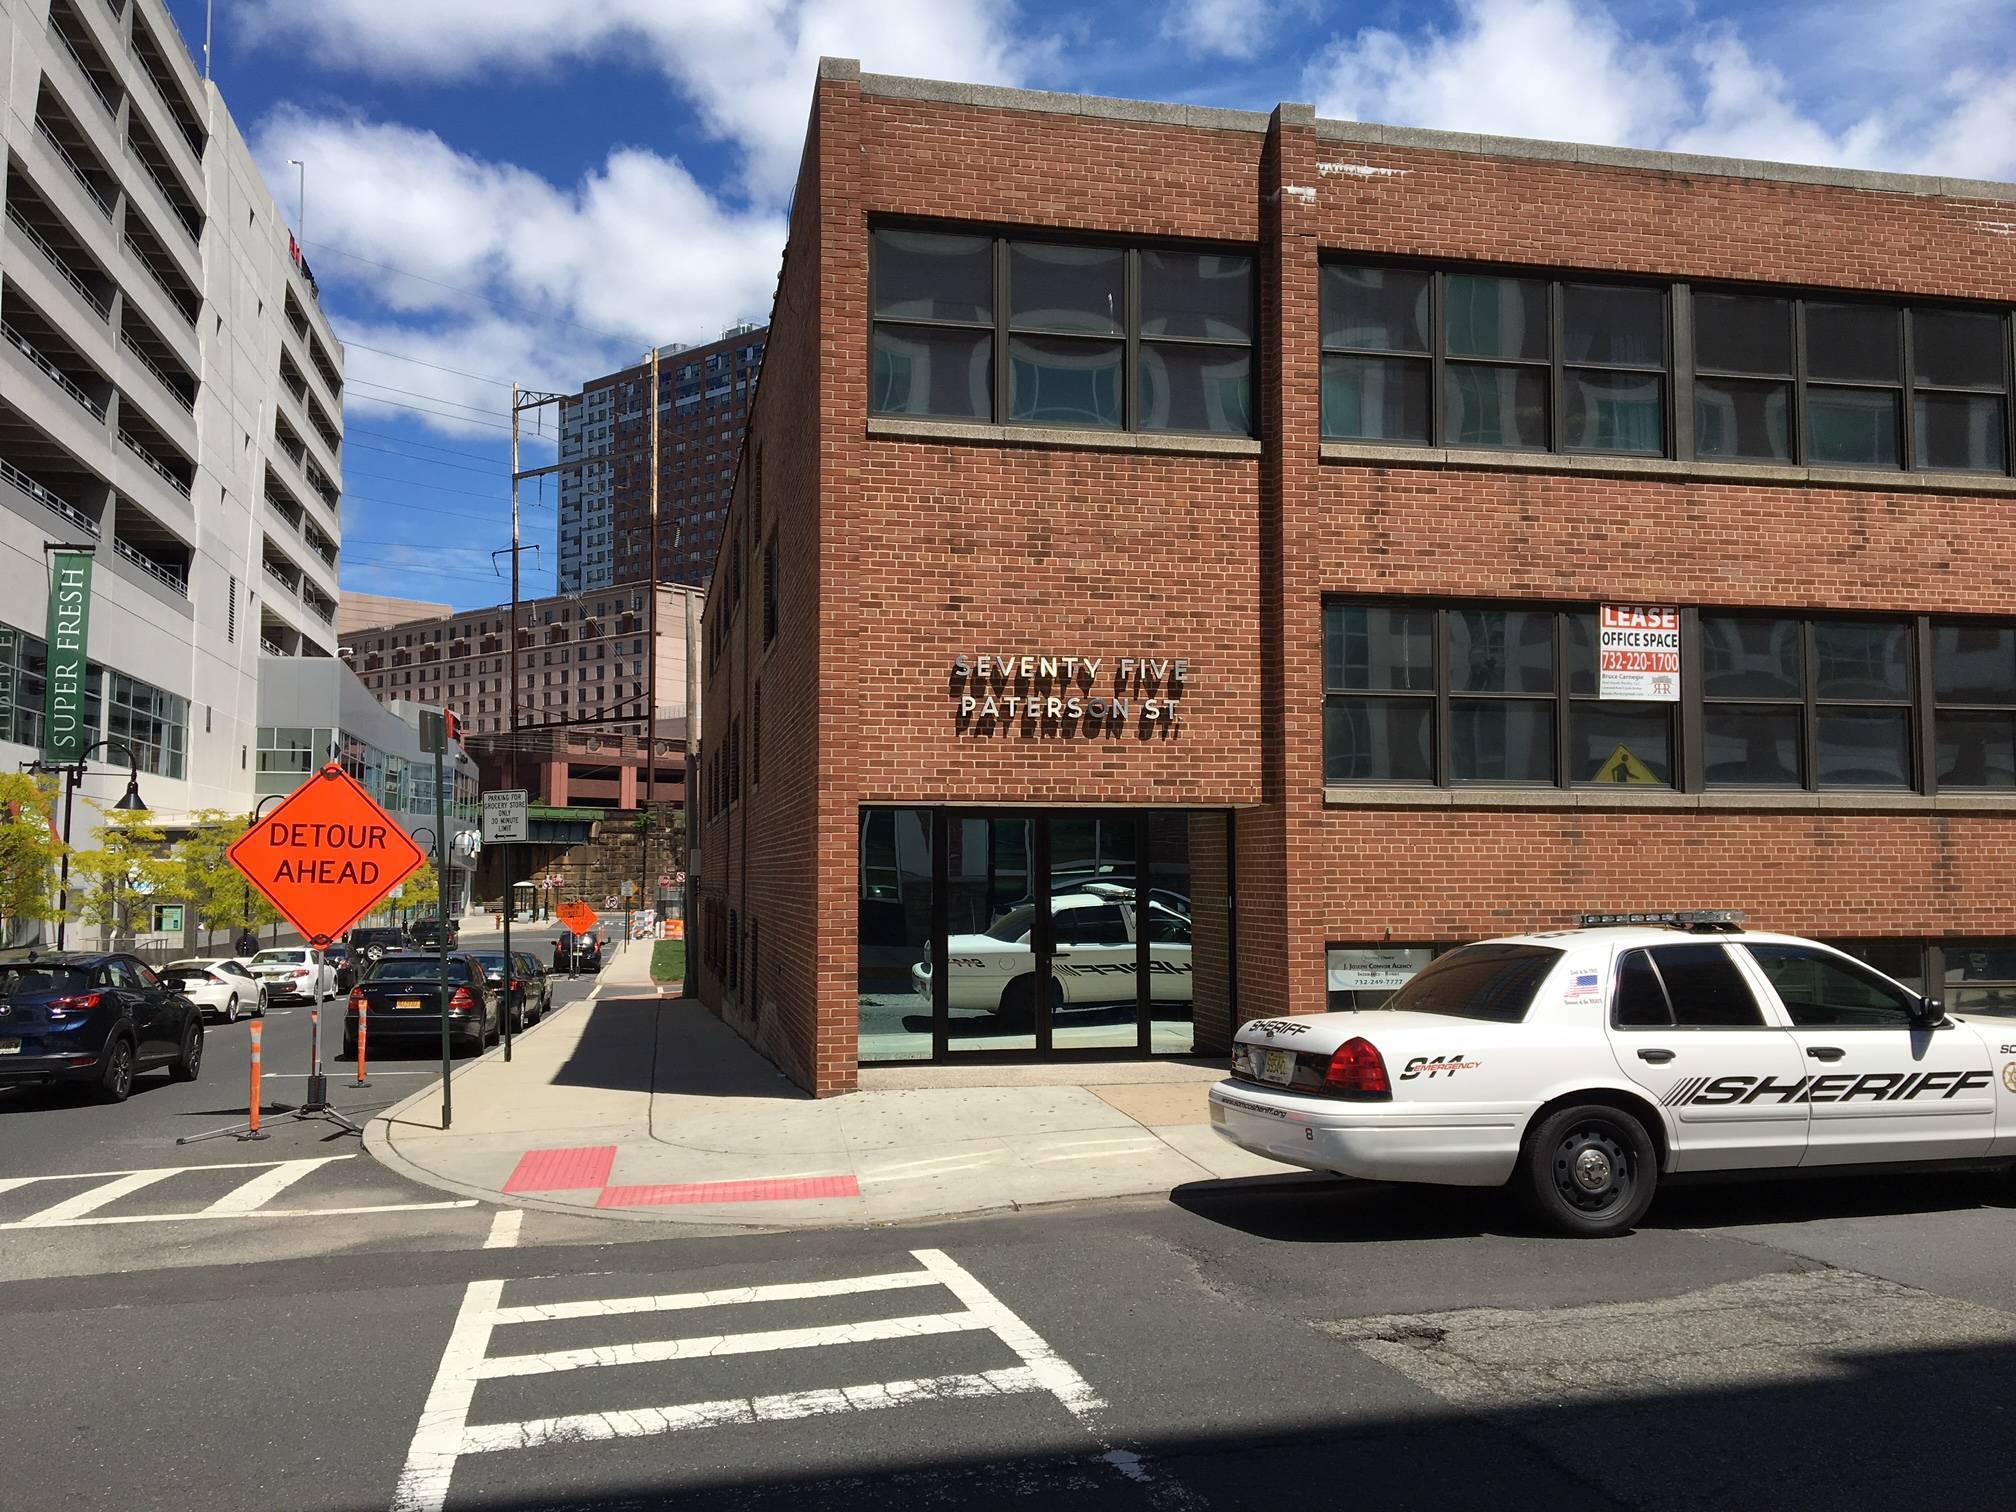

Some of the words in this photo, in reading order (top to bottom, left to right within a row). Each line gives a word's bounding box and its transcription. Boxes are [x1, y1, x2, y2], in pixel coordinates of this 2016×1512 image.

[56, 568, 85, 650] FRESH
[1604, 606, 1675, 628] LEASE
[1602, 631, 1640, 647] OFFICE
[1643, 633, 1678, 648] SPACE
[955, 654, 1102, 679] SEVENTY
[1121, 658, 1188, 682] FIVE
[1602, 651, 1678, 671] 732-220-1700
[53, 660, 79, 747] SUPER
[961, 696, 1128, 720] PATERSON
[269, 822, 387, 849] DETOUR
[272, 859, 380, 885] AHEAD
[1248, 1020, 1312, 1036] SHERIFF
[1413, 1061, 1482, 1072] EMERGENCY
[1691, 1070, 1993, 1105] SHERIFF
[1305, 1127, 1313, 1140] 8
